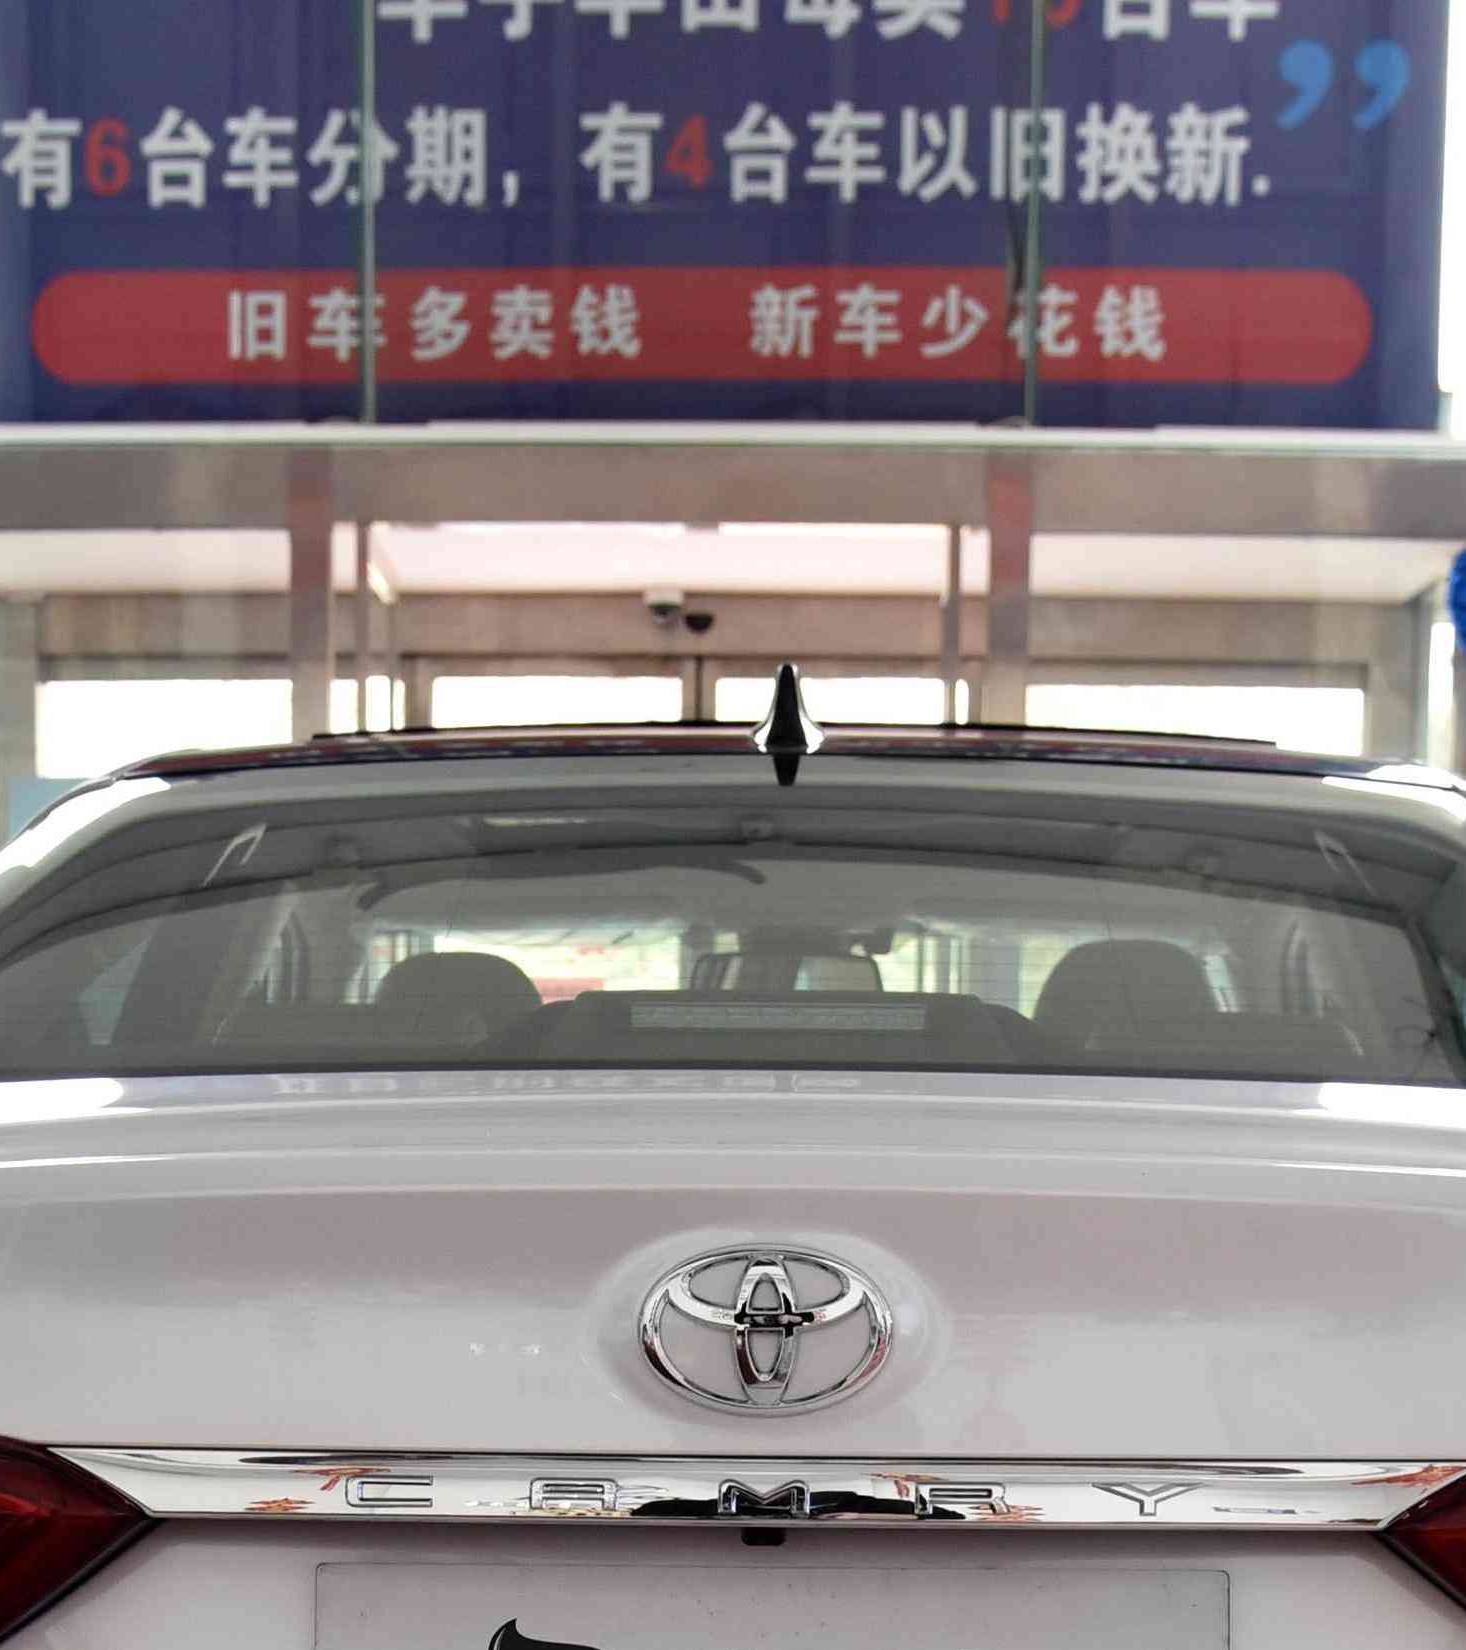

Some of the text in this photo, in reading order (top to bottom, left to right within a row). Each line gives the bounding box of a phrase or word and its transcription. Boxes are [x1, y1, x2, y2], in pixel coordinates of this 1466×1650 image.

[227, 284, 1167, 362] 旧车多卖钱 新车少花钱
[345, 1474, 1206, 1518] CAMRY
